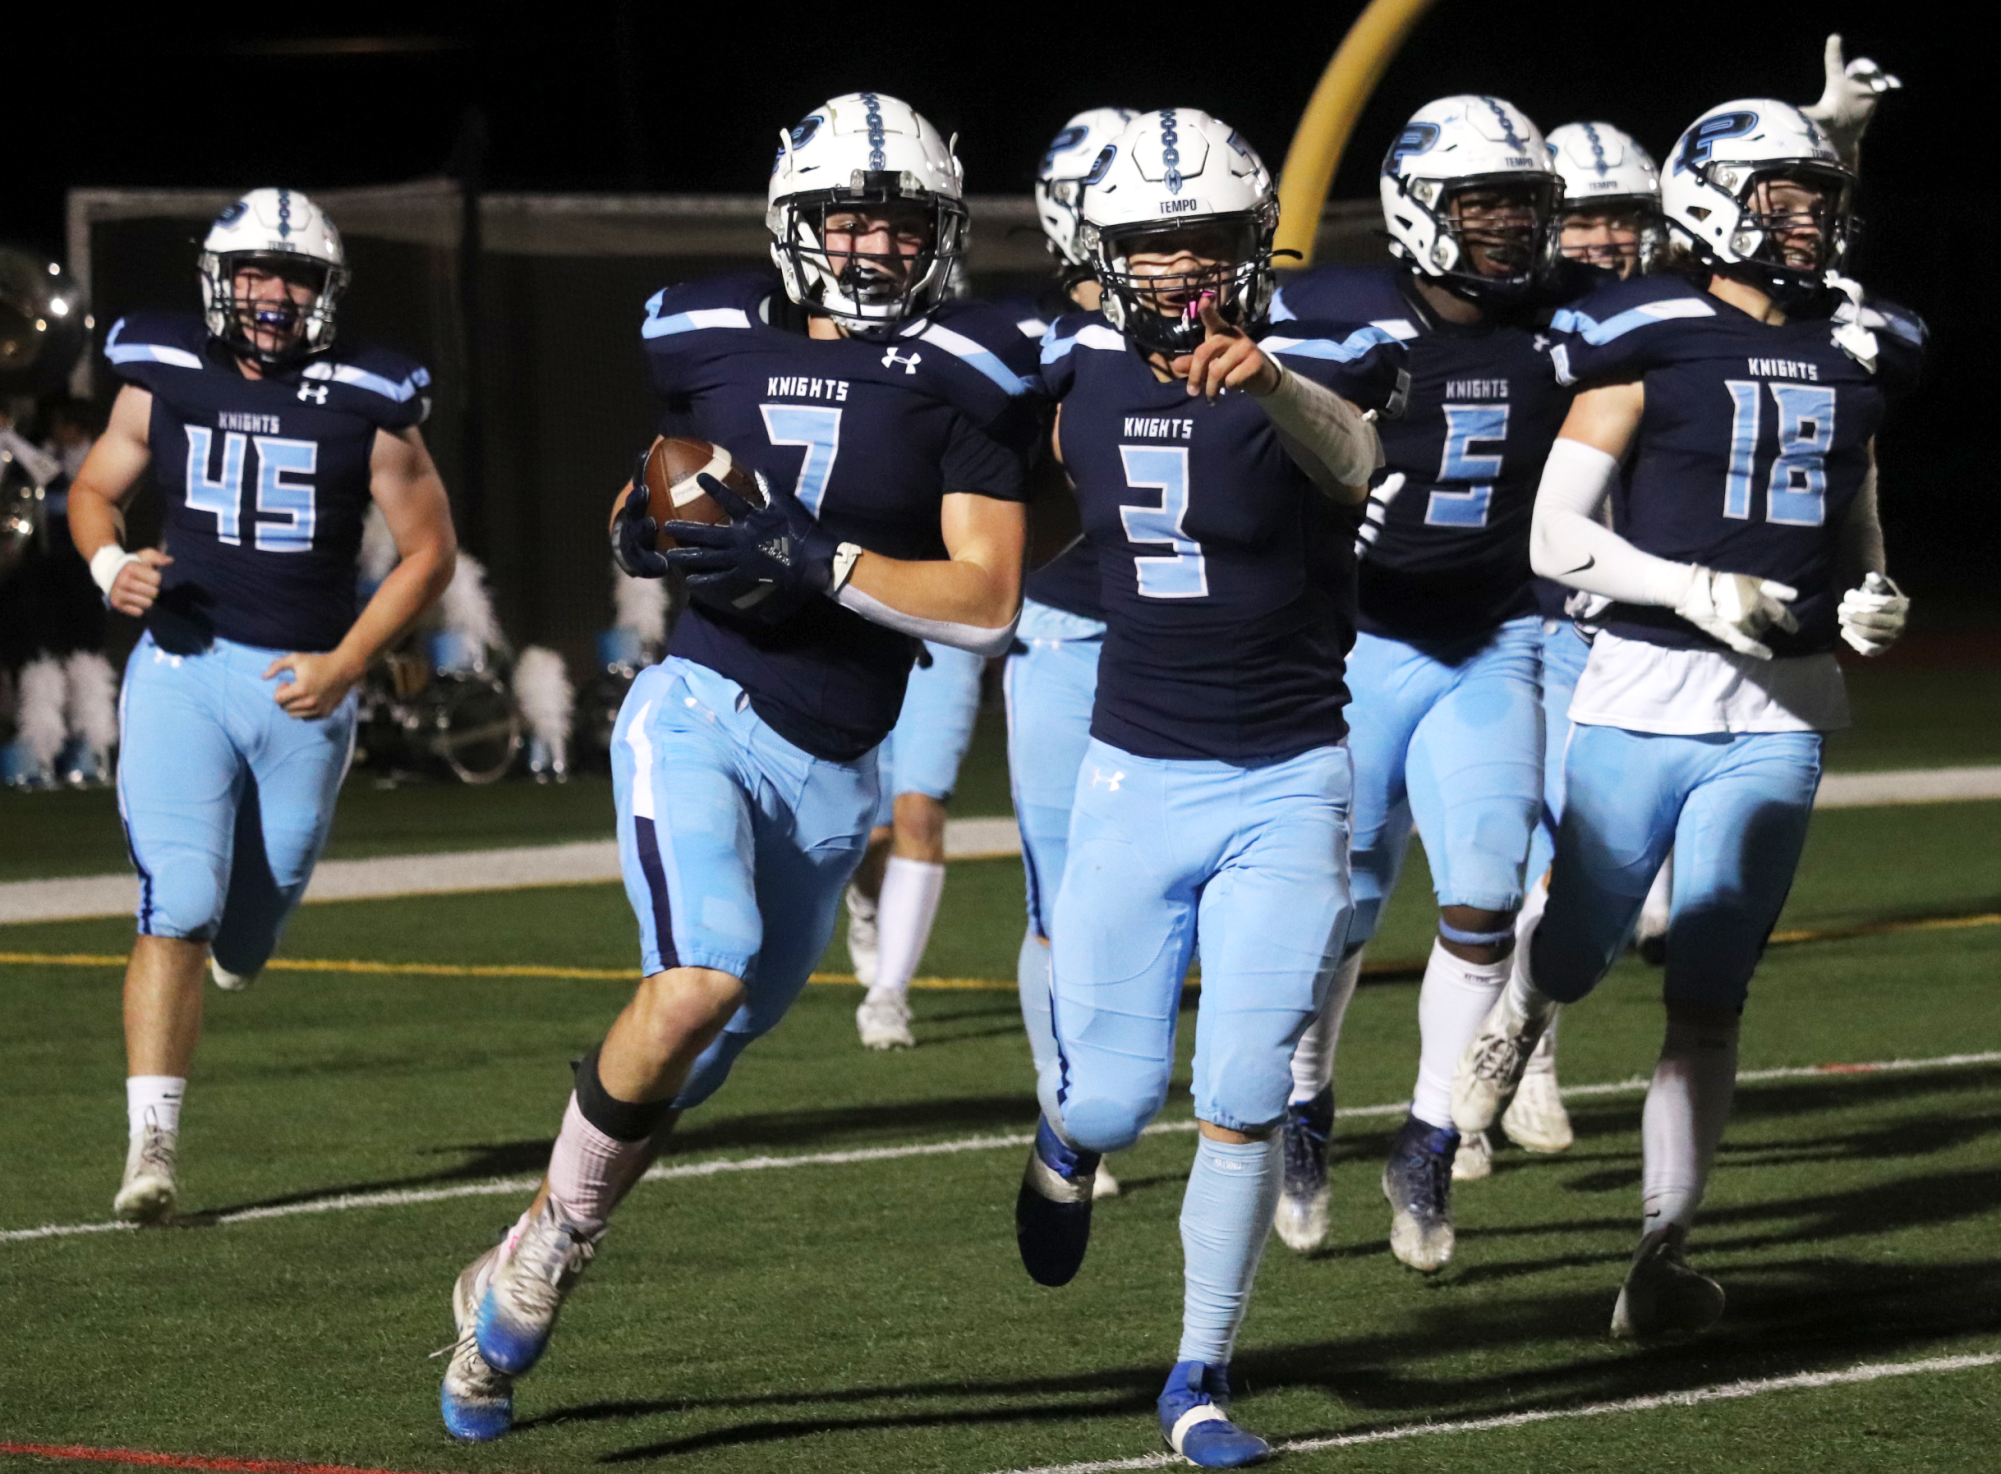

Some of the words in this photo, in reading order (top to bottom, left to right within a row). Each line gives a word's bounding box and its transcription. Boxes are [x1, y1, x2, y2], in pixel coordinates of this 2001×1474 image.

[1672, 110, 1759, 177] P
[1505, 157, 1533, 168] TEMPO
[1588, 181, 1618, 191] TEMPO
[1160, 199, 1197, 214] TEMPO
[1748, 358, 1818, 381] KNIGHTS
[767, 377, 849, 401] KNIGHTS
[1446, 379, 1509, 399] KNIGHTS
[218, 411, 280, 434] KNIGHTS
[1124, 417, 1193, 439] KNIGHTS
[759, 404, 843, 521] 7
[1722, 380, 1836, 527] 18
[1424, 404, 1510, 528] 5
[184, 423, 318, 553] 45
[1118, 444, 1209, 599] 3
